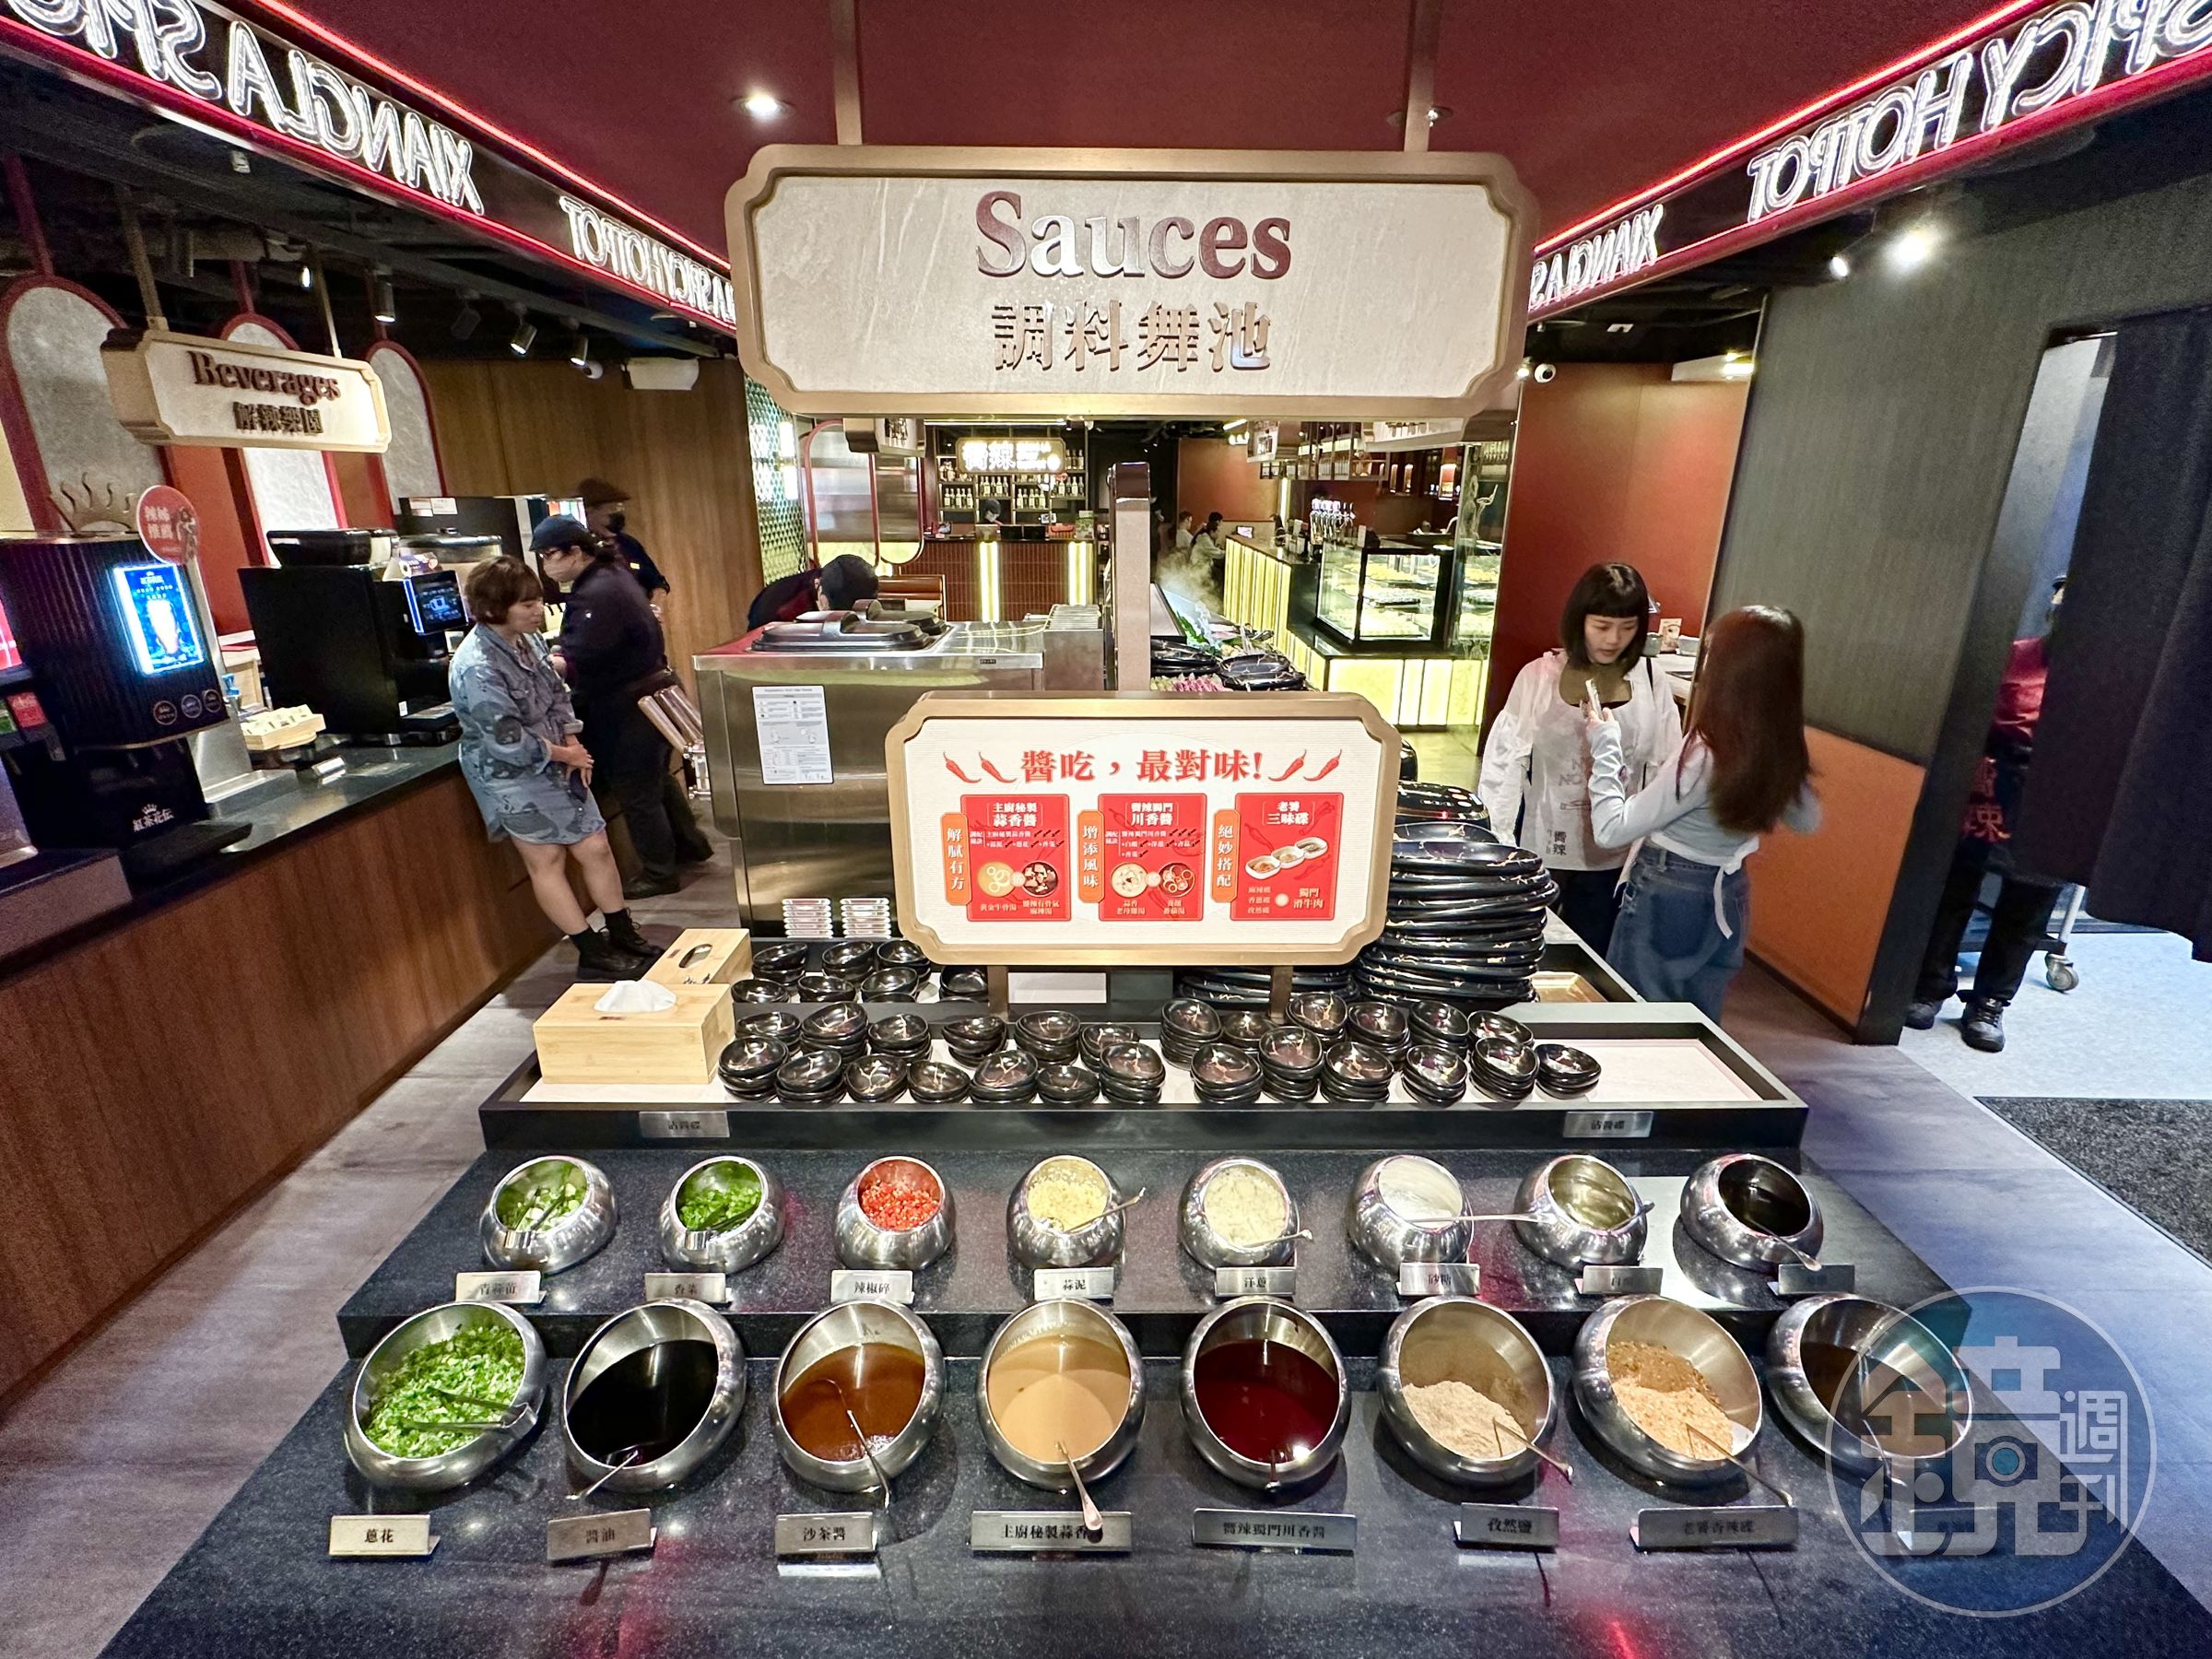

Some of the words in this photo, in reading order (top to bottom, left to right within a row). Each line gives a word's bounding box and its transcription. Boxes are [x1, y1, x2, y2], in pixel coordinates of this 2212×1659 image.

[977, 191, 1291, 279] Sauces
[992, 300, 1272, 372] 調料舞池
[187, 350, 341, 406] Beverages
[1020, 749, 1263, 783] 醬吃，最對味!
[993, 814, 1037, 827] 蒜香醬
[1131, 813, 1173, 826] 川香醬
[1266, 812, 1310, 825] 三味碟
[947, 828, 964, 890] 解膩有方
[1083, 825, 1099, 888] 增添風味
[1217, 824, 1234, 888] 絕妙搭配
[853, 1281, 890, 1295] 辣椒碎
[1062, 1278, 1088, 1291] 蒜泥
[1244, 1276, 1268, 1288] 洋蔥
[1428, 1274, 1452, 1287] 砂糖
[1003, 1524, 1091, 1539] 主廚秘製蒜香
[1487, 1517, 1533, 1534] 孜然鹽
[365, 1528, 394, 1544] 蔥花
[585, 1527, 616, 1544] 醬油
[802, 1526, 846, 1542] 沙茶醬
